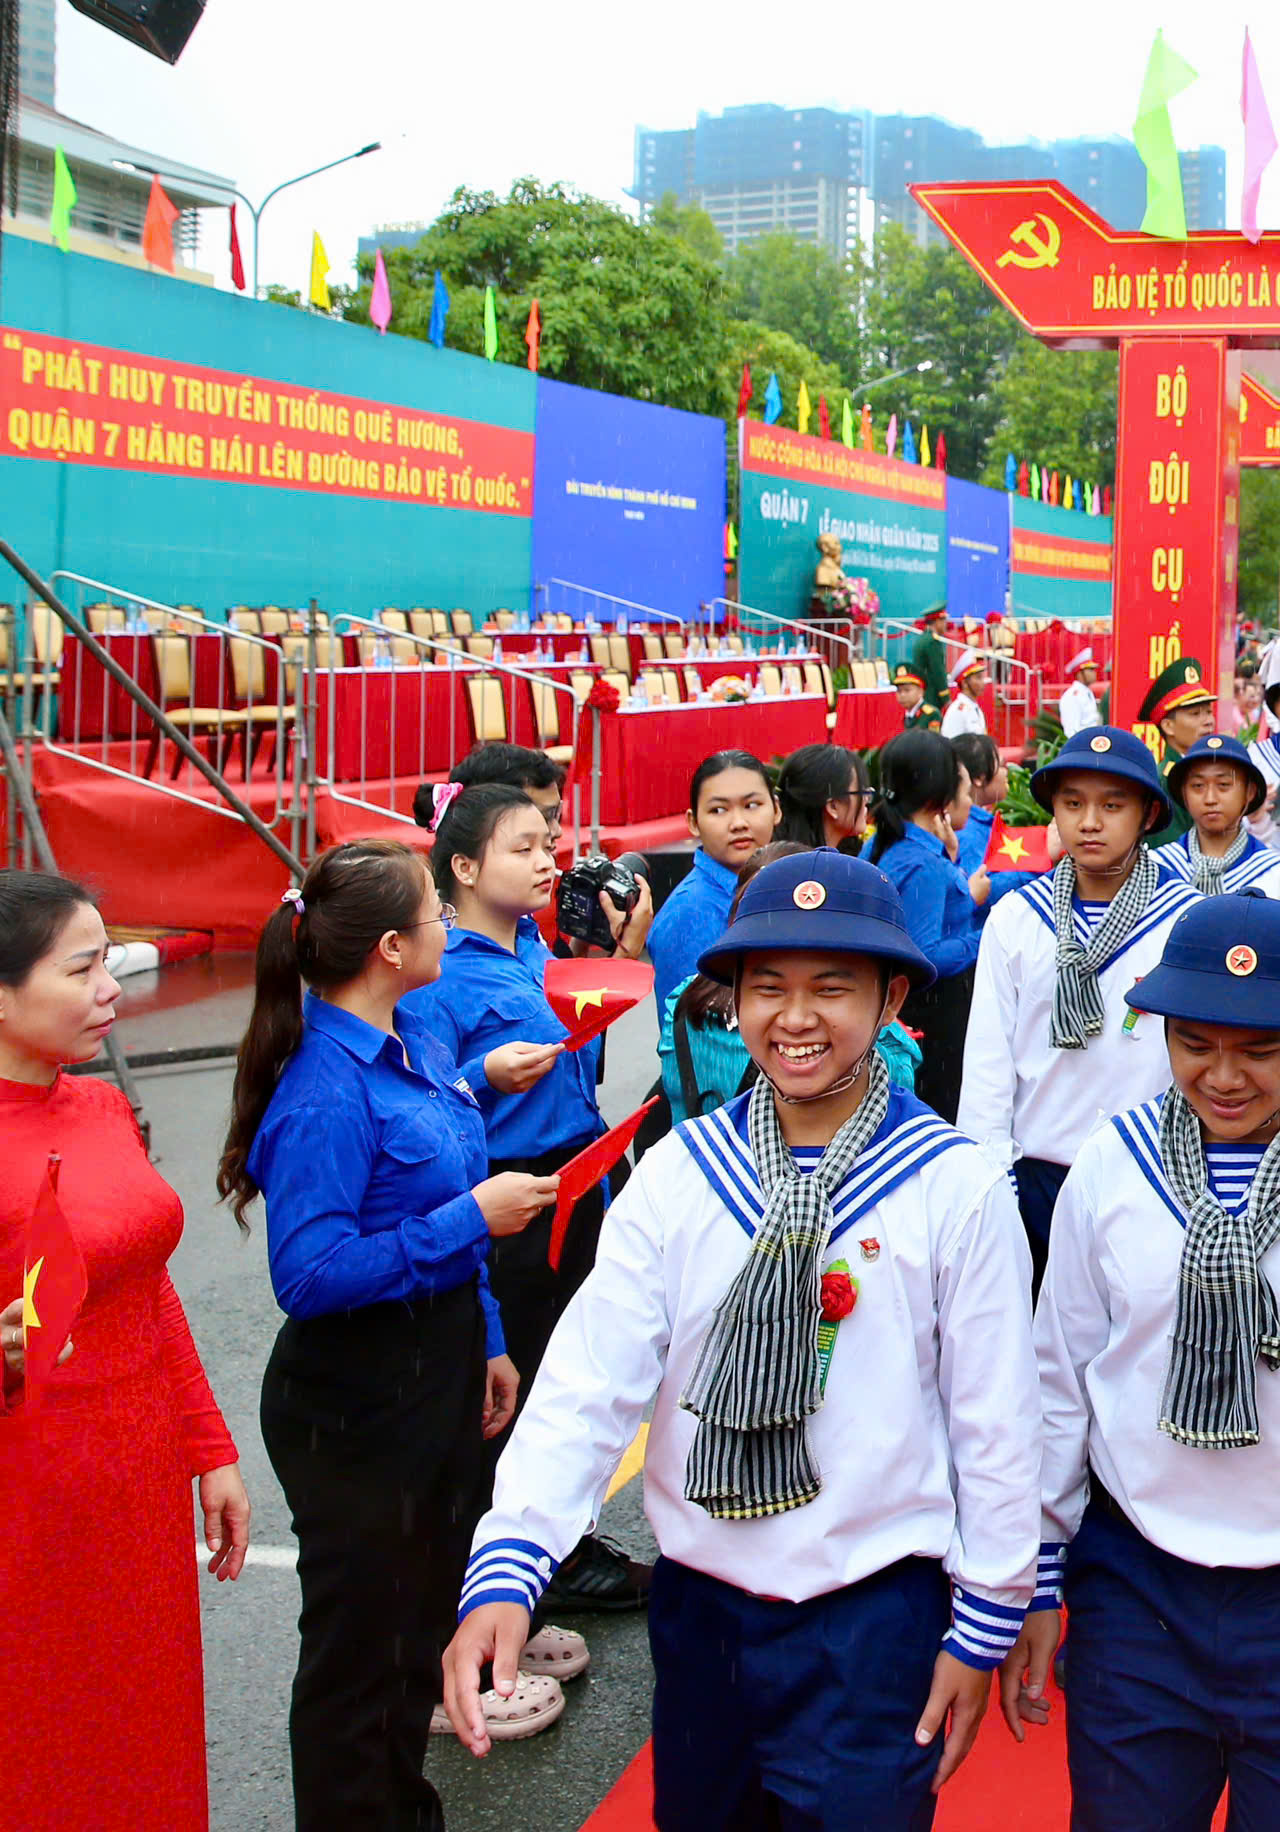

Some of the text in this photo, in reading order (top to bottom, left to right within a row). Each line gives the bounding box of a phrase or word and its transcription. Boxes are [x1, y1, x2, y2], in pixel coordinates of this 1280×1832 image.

[1093, 263, 1131, 309] BẢO
[1136, 267, 1158, 317] VỆ
[1164, 259, 1188, 309] TỔ
[1192, 260, 1243, 312] QUỐC
[1248, 265, 1271, 307] LÀ
[109, 363, 166, 406] HUY
[170, 375, 272, 423] TRUYỀN
[276, 392, 349, 437] THỐNG
[354, 410, 393, 444] QUÊ
[1156, 364, 1188, 427] BỘ
[8, 407, 95, 459] QUẬN
[102, 422, 121, 457] 7
[127, 422, 205, 468] HĂNG
[210, 435, 253, 474] HÁI
[258, 441, 303, 481] LÊN
[308, 450, 380, 490] ĐƯỜNG
[384, 456, 422, 495] BẢO
[426, 466, 447, 504] VỆ
[451, 465, 472, 502] TỔ
[1150, 451, 1189, 515] ĐỘI
[760, 488, 809, 528] QUẬN 7
[1152, 548, 1183, 603] CỤ
